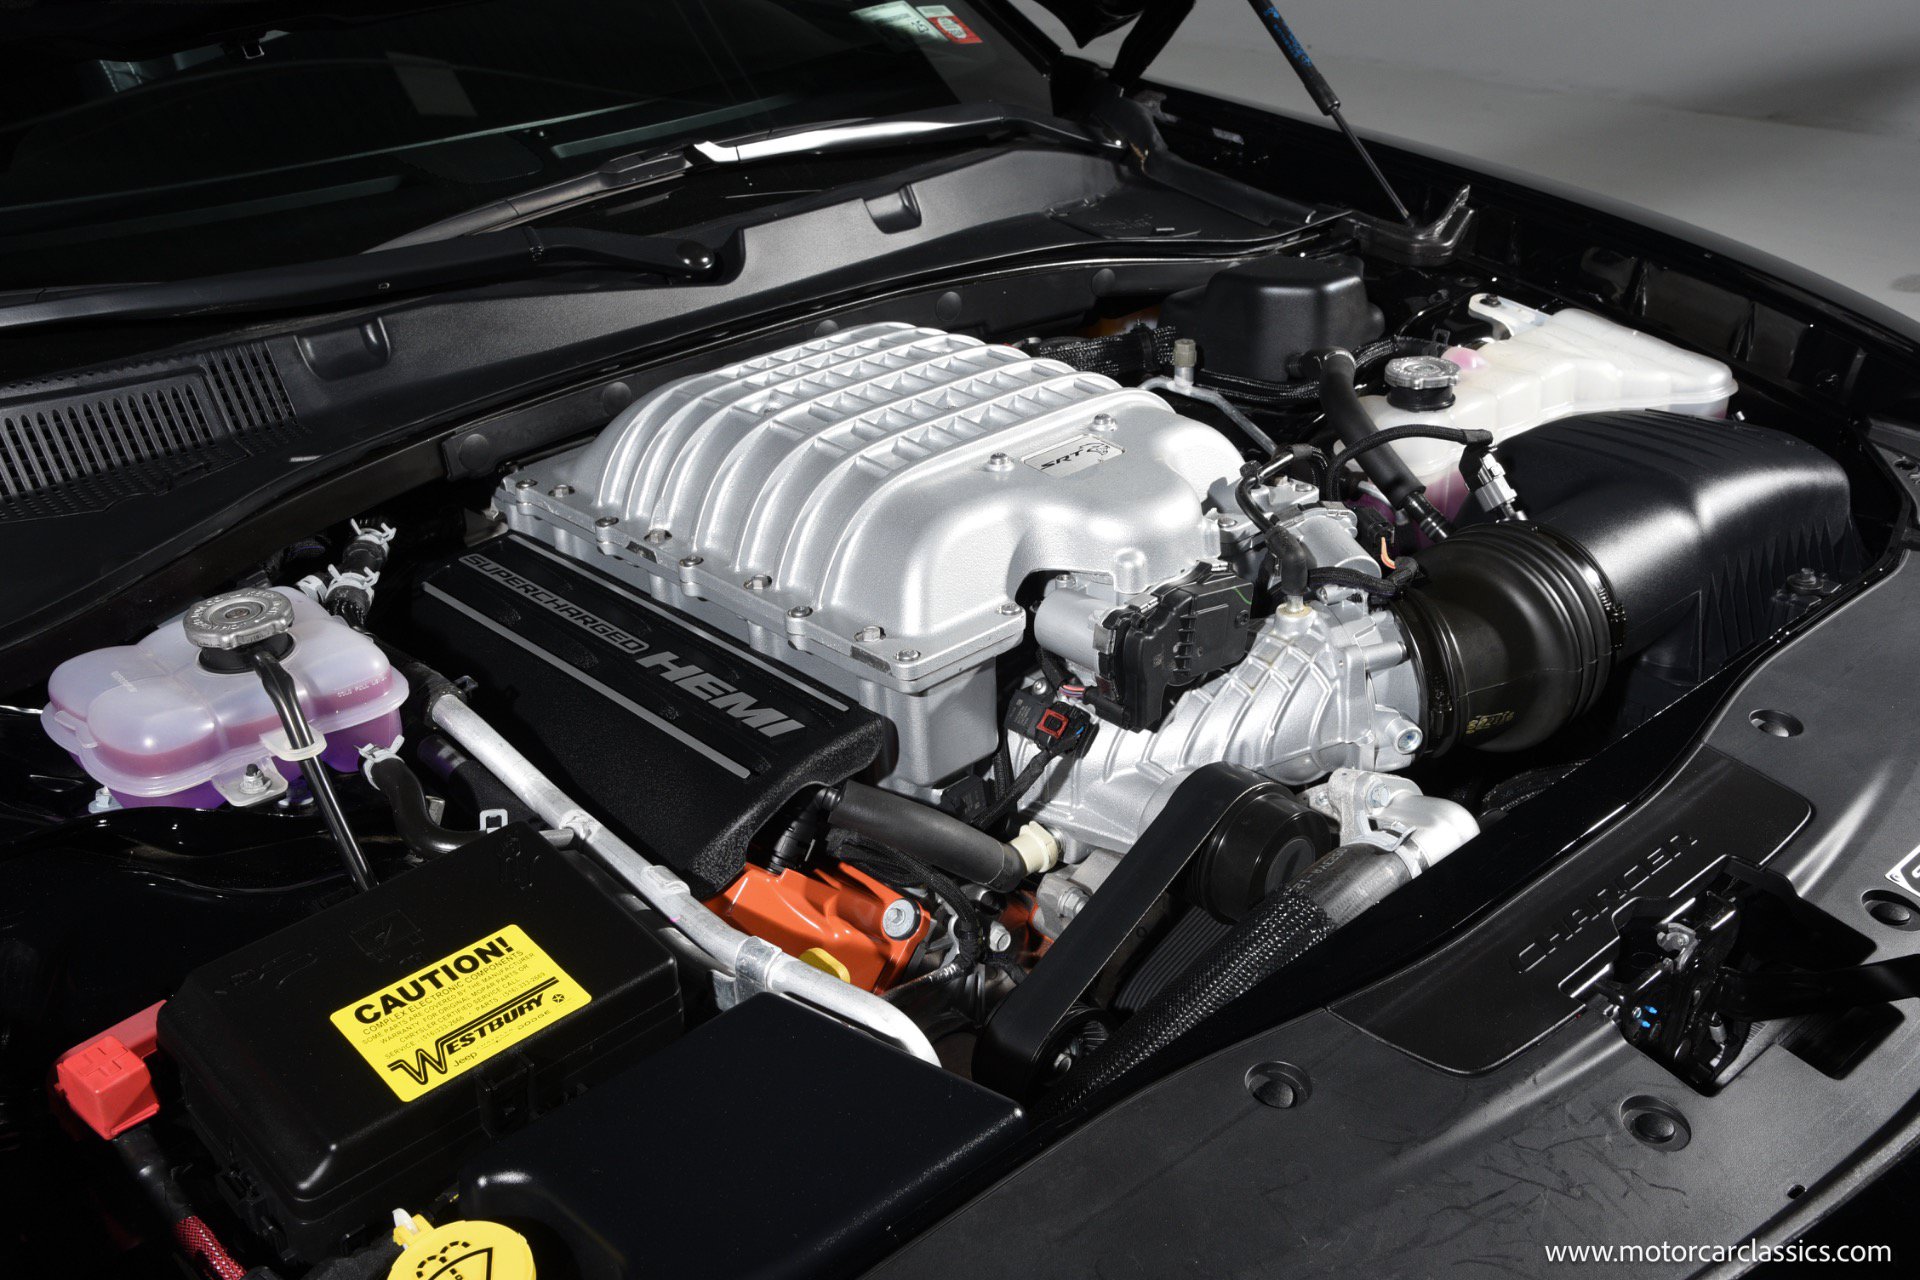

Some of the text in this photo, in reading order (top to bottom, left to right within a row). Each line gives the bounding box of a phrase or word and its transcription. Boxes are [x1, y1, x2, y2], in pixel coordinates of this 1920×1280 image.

[461, 553, 649, 653] SUPERCHARGED
[634, 650, 805, 739] HEMI
[353, 936, 514, 1025] CAUTION!
[361, 949, 524, 1036] COMPLEX ELECTRONIC COMPONENTS
[383, 1019, 408, 1033] PARTS
[407, 1011, 423, 1021] ARE
[422, 993, 457, 1013] COVERED
[480, 952, 535, 982] MANUFACTURER
[398, 977, 520, 1043] CHRYSLER CERTIFIED SERVICE CALL
[436, 995, 470, 1014] ORIGINAL
[470, 981, 496, 997] MOPAR
[495, 969, 519, 983] PARTS
[387, 991, 544, 1085] WESTBURY
[450, 1049, 479, 1068] Jeep
